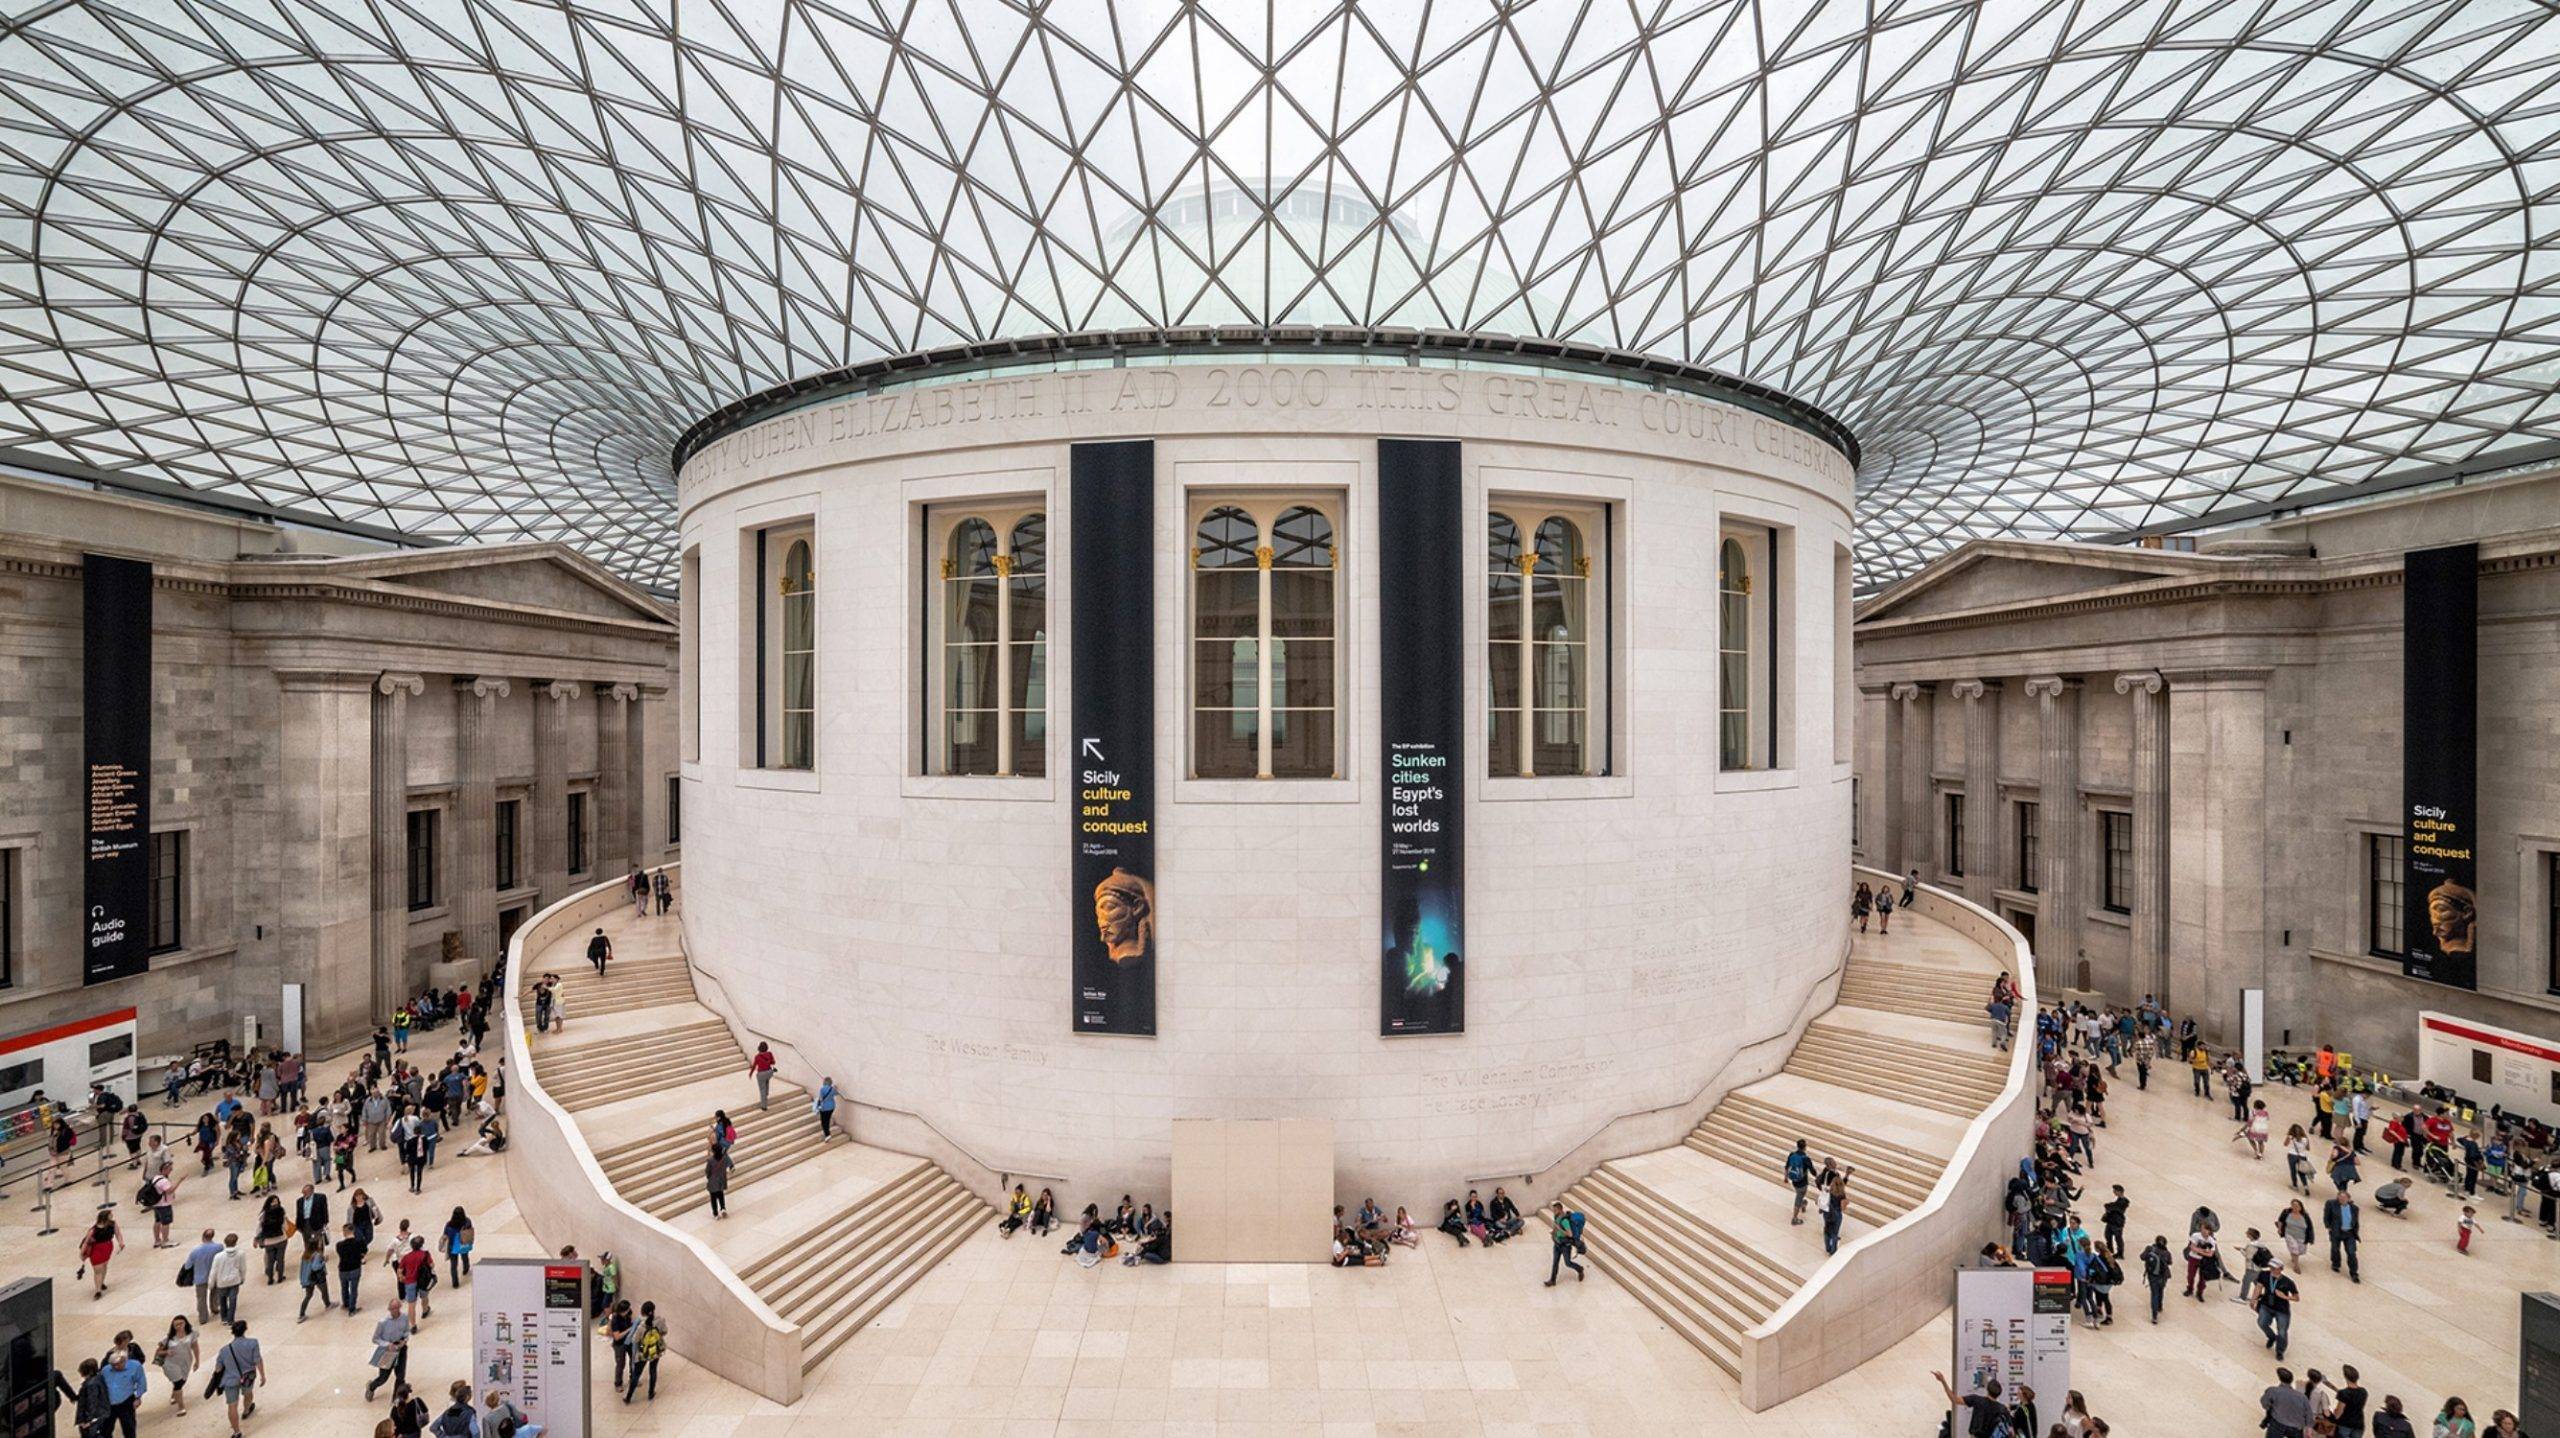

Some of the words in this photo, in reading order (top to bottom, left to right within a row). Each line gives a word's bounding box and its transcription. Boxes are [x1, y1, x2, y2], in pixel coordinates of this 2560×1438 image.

[739, 411, 818, 468] QUEEN
[828, 377, 1043, 442] ELIZABETH
[1061, 373, 1094, 414] II
[1110, 369, 1181, 411] AD
[1206, 368, 1329, 408] 2000
[1350, 369, 1461, 411] THIS
[1484, 375, 1623, 426] GREAT
[1640, 394, 1742, 447] COURT
[1392, 753, 1446, 767] Sunken
[1083, 770, 1120, 786] Sicily
[1392, 771, 1430, 783] cities
[1083, 787, 1131, 800] culture
[1392, 786, 1443, 802] Egypt's
[1083, 803, 1109, 816] and
[1392, 803, 1418, 816] lost
[2413, 804, 2446, 820] Sicily
[1083, 820, 1148, 835] conquest
[1392, 819, 1440, 832] worlds
[2413, 819, 2456, 832] culture
[2413, 832, 2436, 842] and
[2413, 845, 2471, 860] conquest
[92, 918, 126, 933] Audio
[92, 931, 124, 948] guide
[2500, 1039, 2543, 1056] Membership
